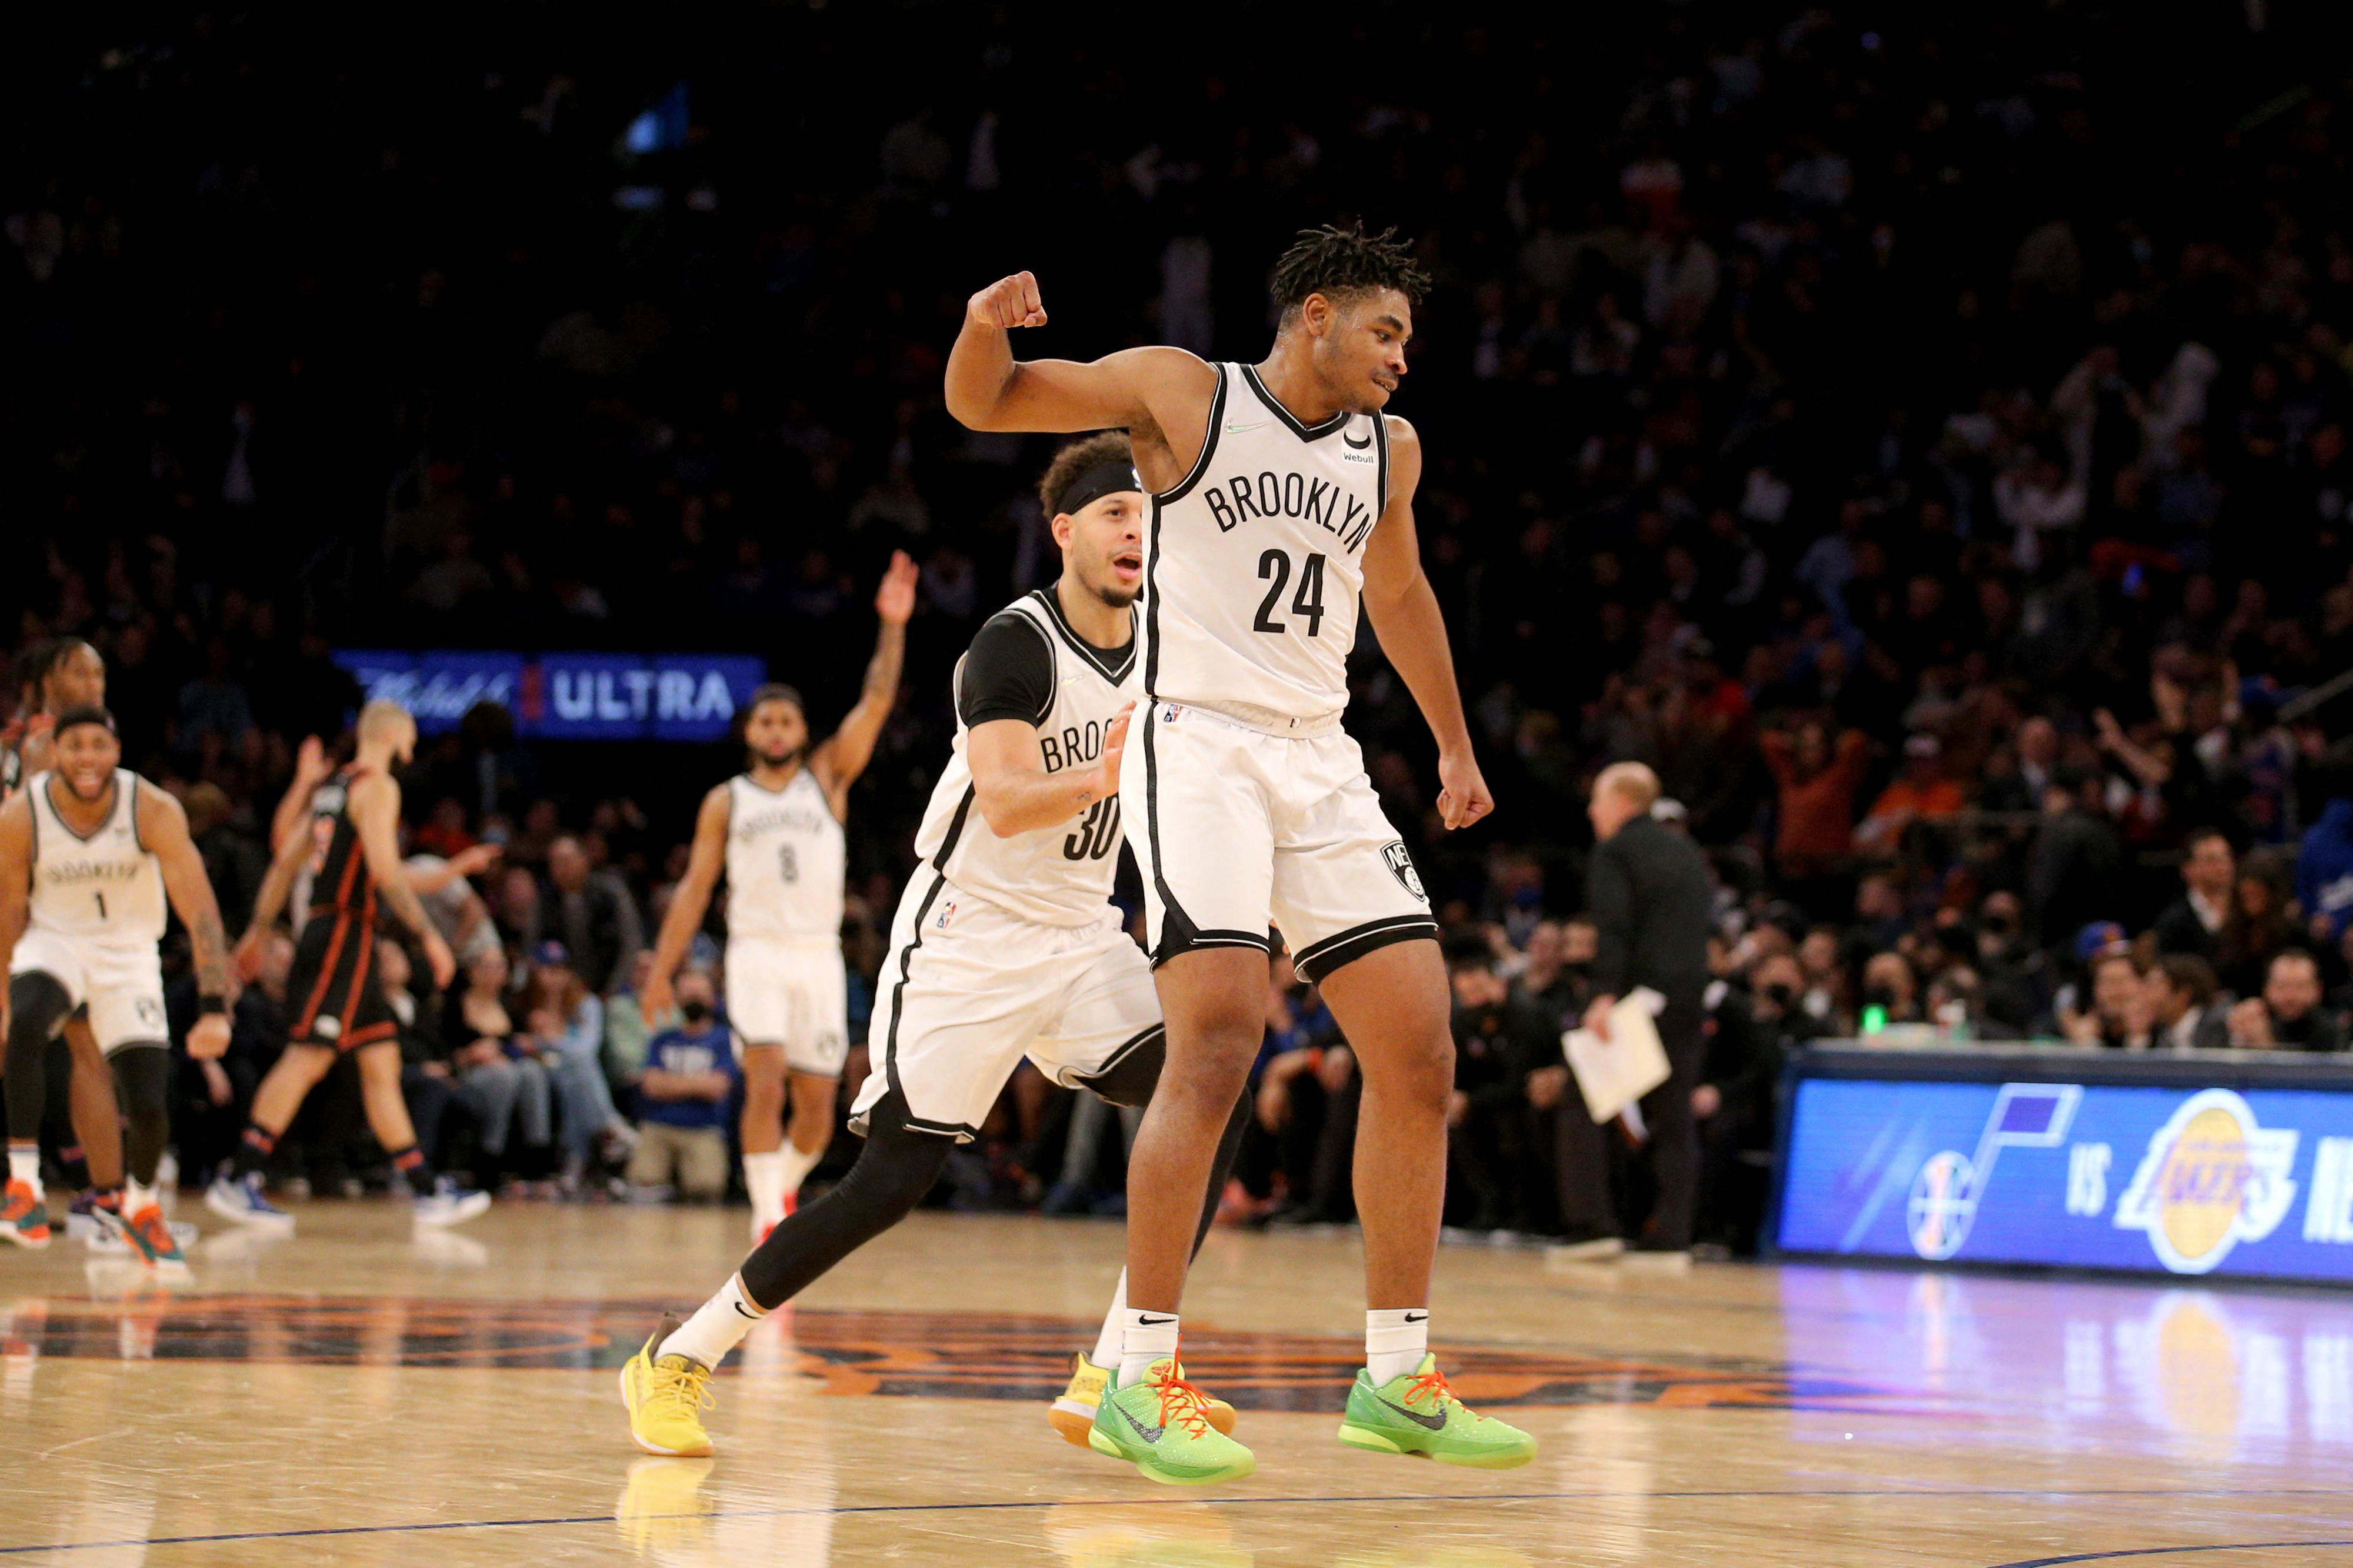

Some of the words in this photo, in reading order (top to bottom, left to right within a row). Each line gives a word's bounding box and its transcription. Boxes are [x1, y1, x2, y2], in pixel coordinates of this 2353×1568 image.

[1343, 452, 1374, 463] Webull
[1204, 471, 1372, 555] BROOKLYN
[1253, 548, 1326, 637] 24
[553, 669, 735, 721] ULTRA
[1063, 792, 1120, 860] 30
[95, 890, 107, 919] 1
